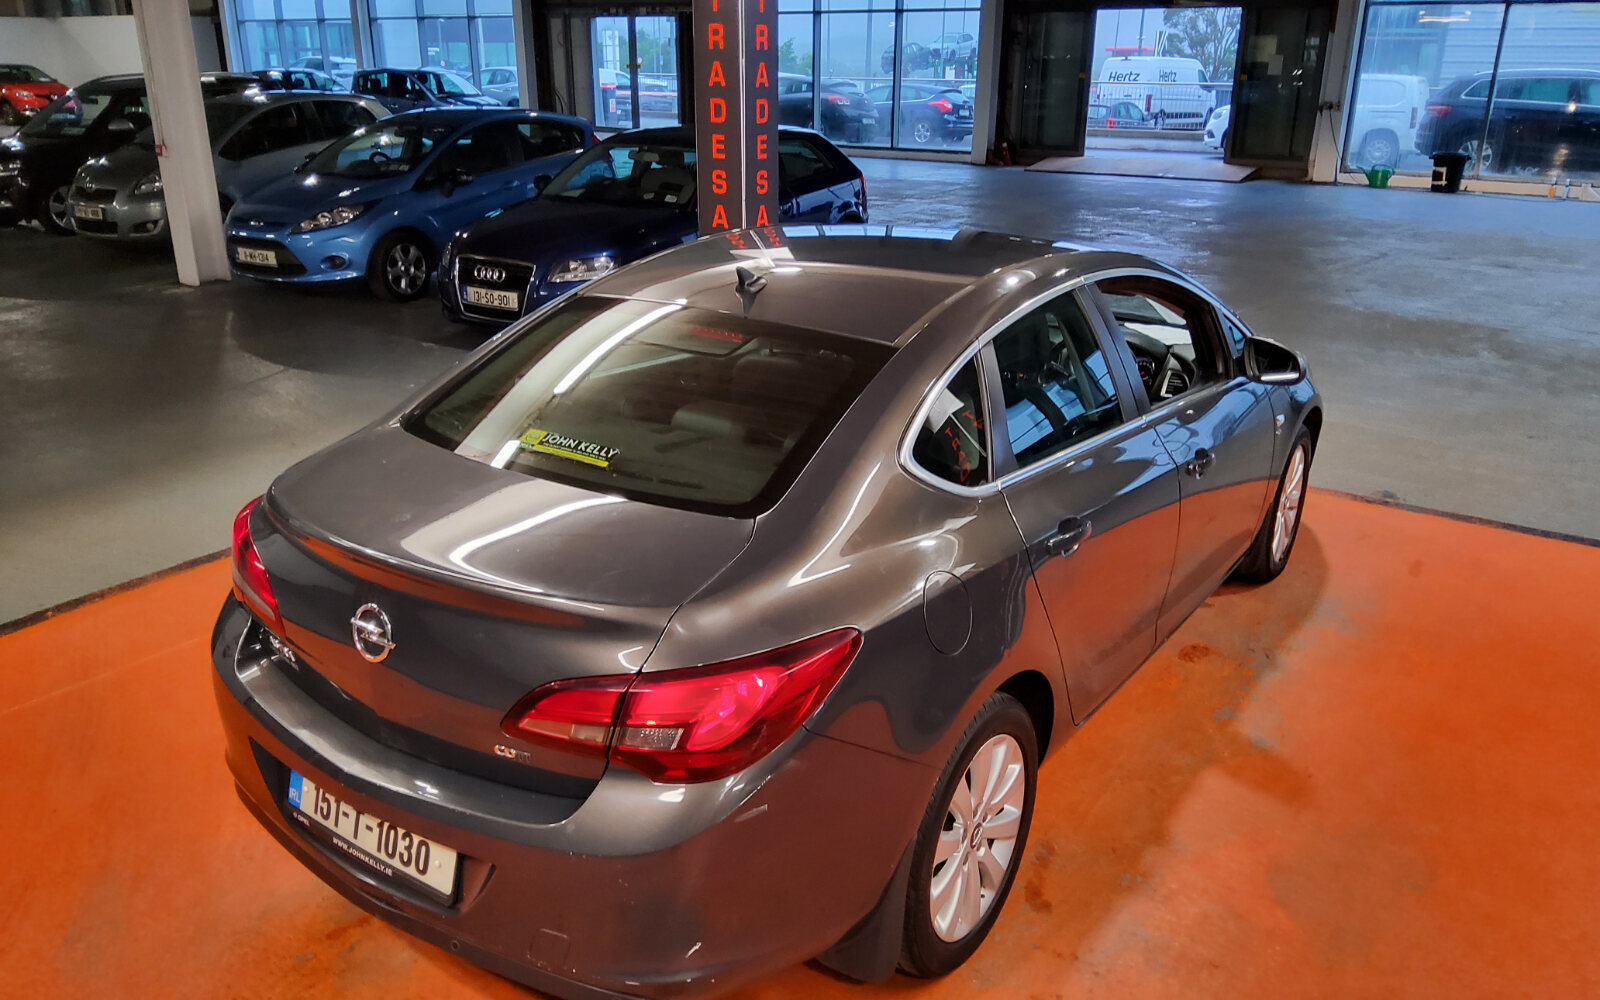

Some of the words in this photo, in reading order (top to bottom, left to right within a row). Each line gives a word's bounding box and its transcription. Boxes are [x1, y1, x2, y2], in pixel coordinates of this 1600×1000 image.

[1108, 70, 1141, 82] Hertz
[1158, 69, 1177, 82] Hertz
[473, 290, 511, 306] 131-SO-901
[542, 432, 579, 450] JOHN
[577, 442, 618, 458] KELLY
[288, 787, 300, 803] IRL
[313, 786, 431, 876] 151-T-1030
[332, 836, 393, 876] WWW.JOHNKELLY.IE
